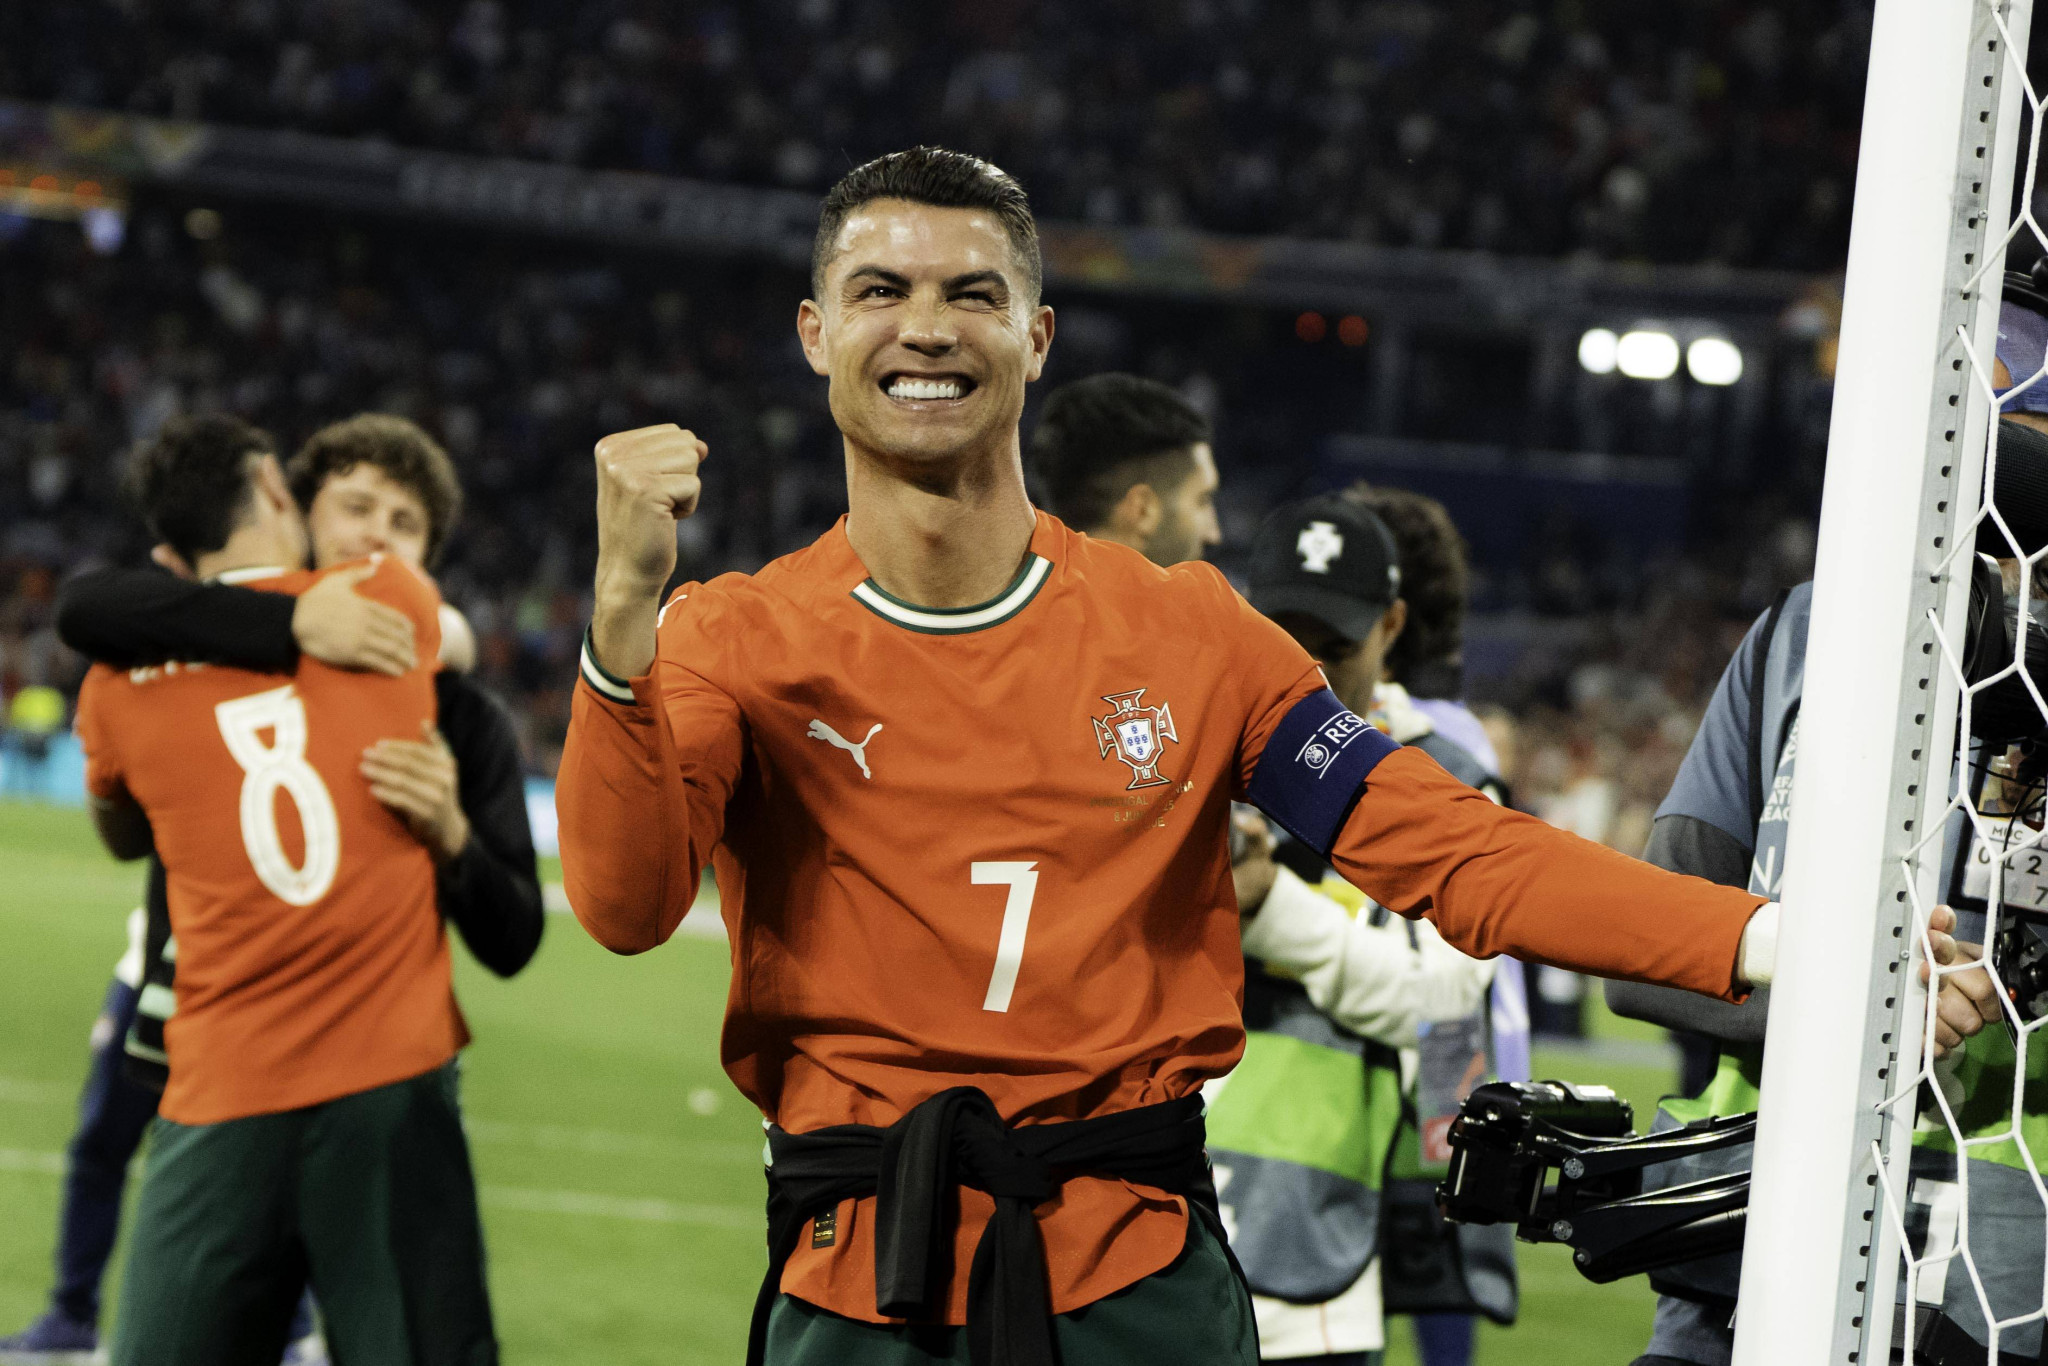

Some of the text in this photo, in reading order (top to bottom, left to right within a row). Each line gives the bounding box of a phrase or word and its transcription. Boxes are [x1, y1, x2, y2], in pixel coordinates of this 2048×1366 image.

[1773, 776, 1794, 790] EFA
[215, 685, 341, 906] 8
[1766, 789, 1791, 806] AT
[2026, 855, 2042, 875] 2
[2034, 886, 2048, 904] 7
[971, 861, 1039, 1013] 7
